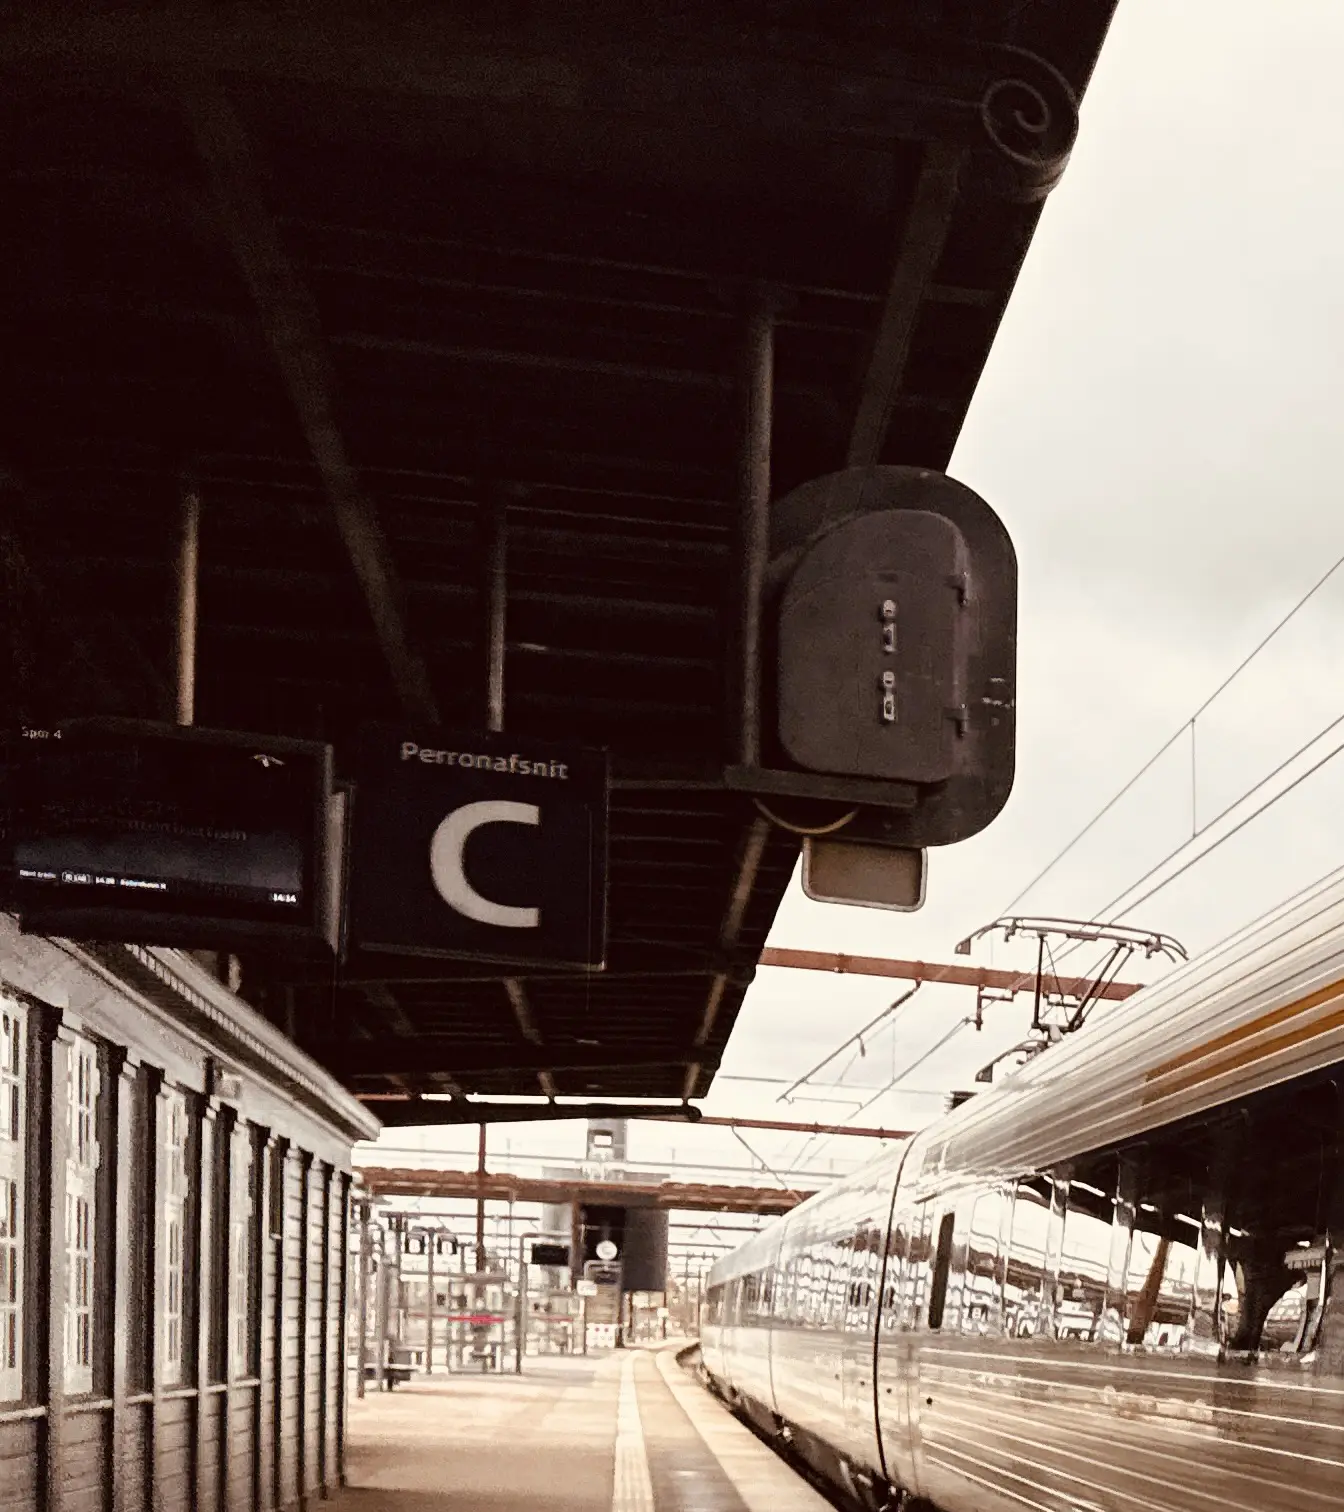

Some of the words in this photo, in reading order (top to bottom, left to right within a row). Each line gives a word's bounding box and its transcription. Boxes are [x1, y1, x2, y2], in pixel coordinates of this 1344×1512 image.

[53, 729, 63, 740] 4
[400, 741, 569, 780] Perronafsnit
[430, 800, 541, 928] C
